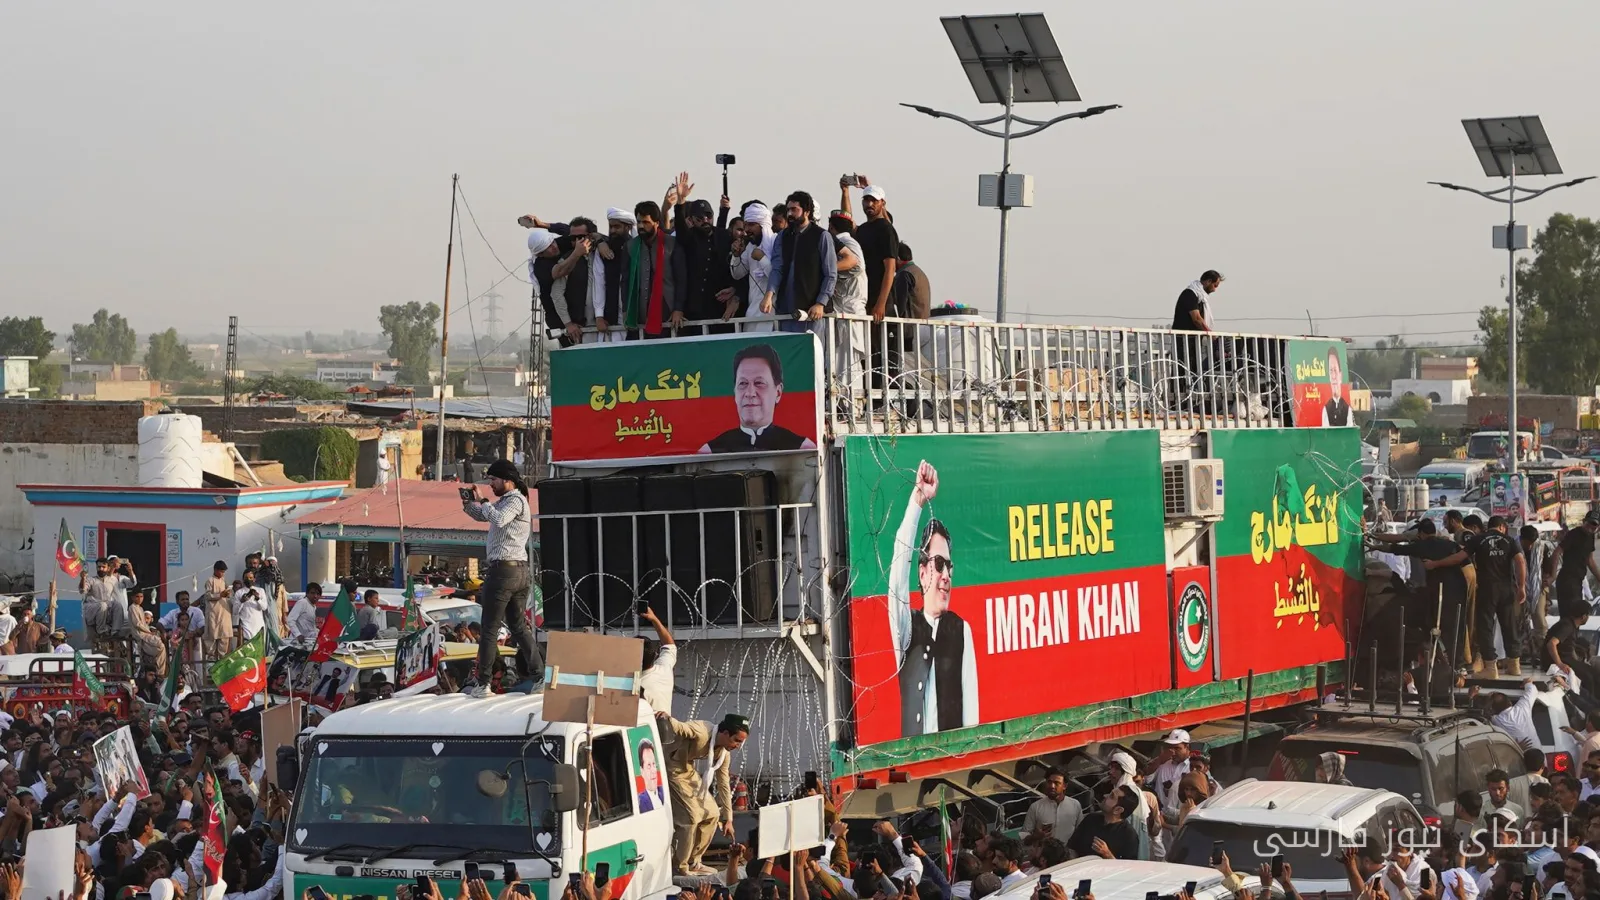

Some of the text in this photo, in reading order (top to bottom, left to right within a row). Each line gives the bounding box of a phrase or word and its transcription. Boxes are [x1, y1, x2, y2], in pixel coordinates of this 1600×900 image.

[590, 368, 701, 411] لانگ مارچ
[1008, 499, 1114, 562] RELEASE
[1251, 484, 1339, 565] لانگ مارچ
[985, 580, 1141, 655] IMRAN KHAN
[361, 868, 460, 879] NISSAN DIESEL
